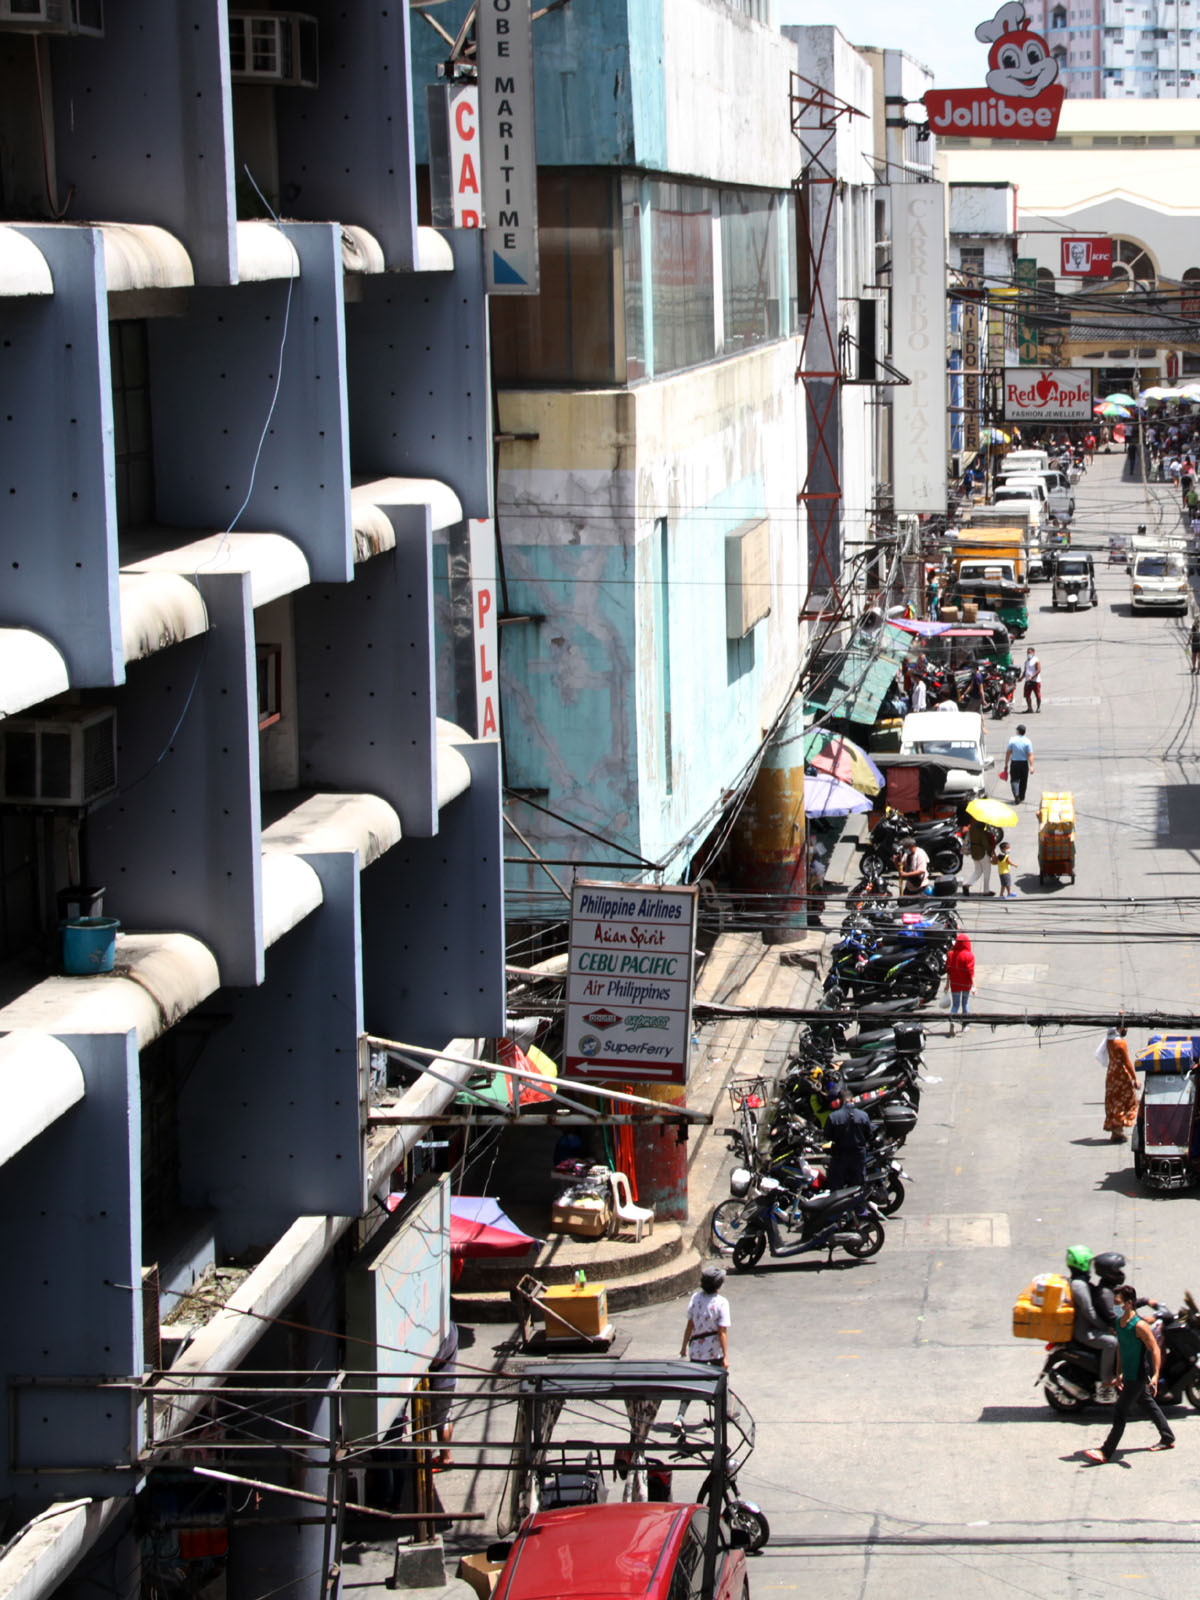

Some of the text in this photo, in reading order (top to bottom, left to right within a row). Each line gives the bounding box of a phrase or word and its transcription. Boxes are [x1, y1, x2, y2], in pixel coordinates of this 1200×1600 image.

[933, 97, 1052, 127] Jollibee
[494, 77, 519, 249] MARITIME
[1092, 253, 1110, 261] KFC
[908, 198, 930, 351] CARRIEDO
[965, 267, 977, 367] CARIEDO
[1007, 384, 1090, 408] Red Apple
[910, 369, 930, 464] PLAZA
[580, 895, 682, 919] Philippine Airlines
[594, 923, 665, 949] Asian Spirit
[578, 952, 678, 976] CEBU PACIFIC
[583, 980, 670, 1004] Air Philippines
[603, 1040, 674, 1058] SuperFerry
